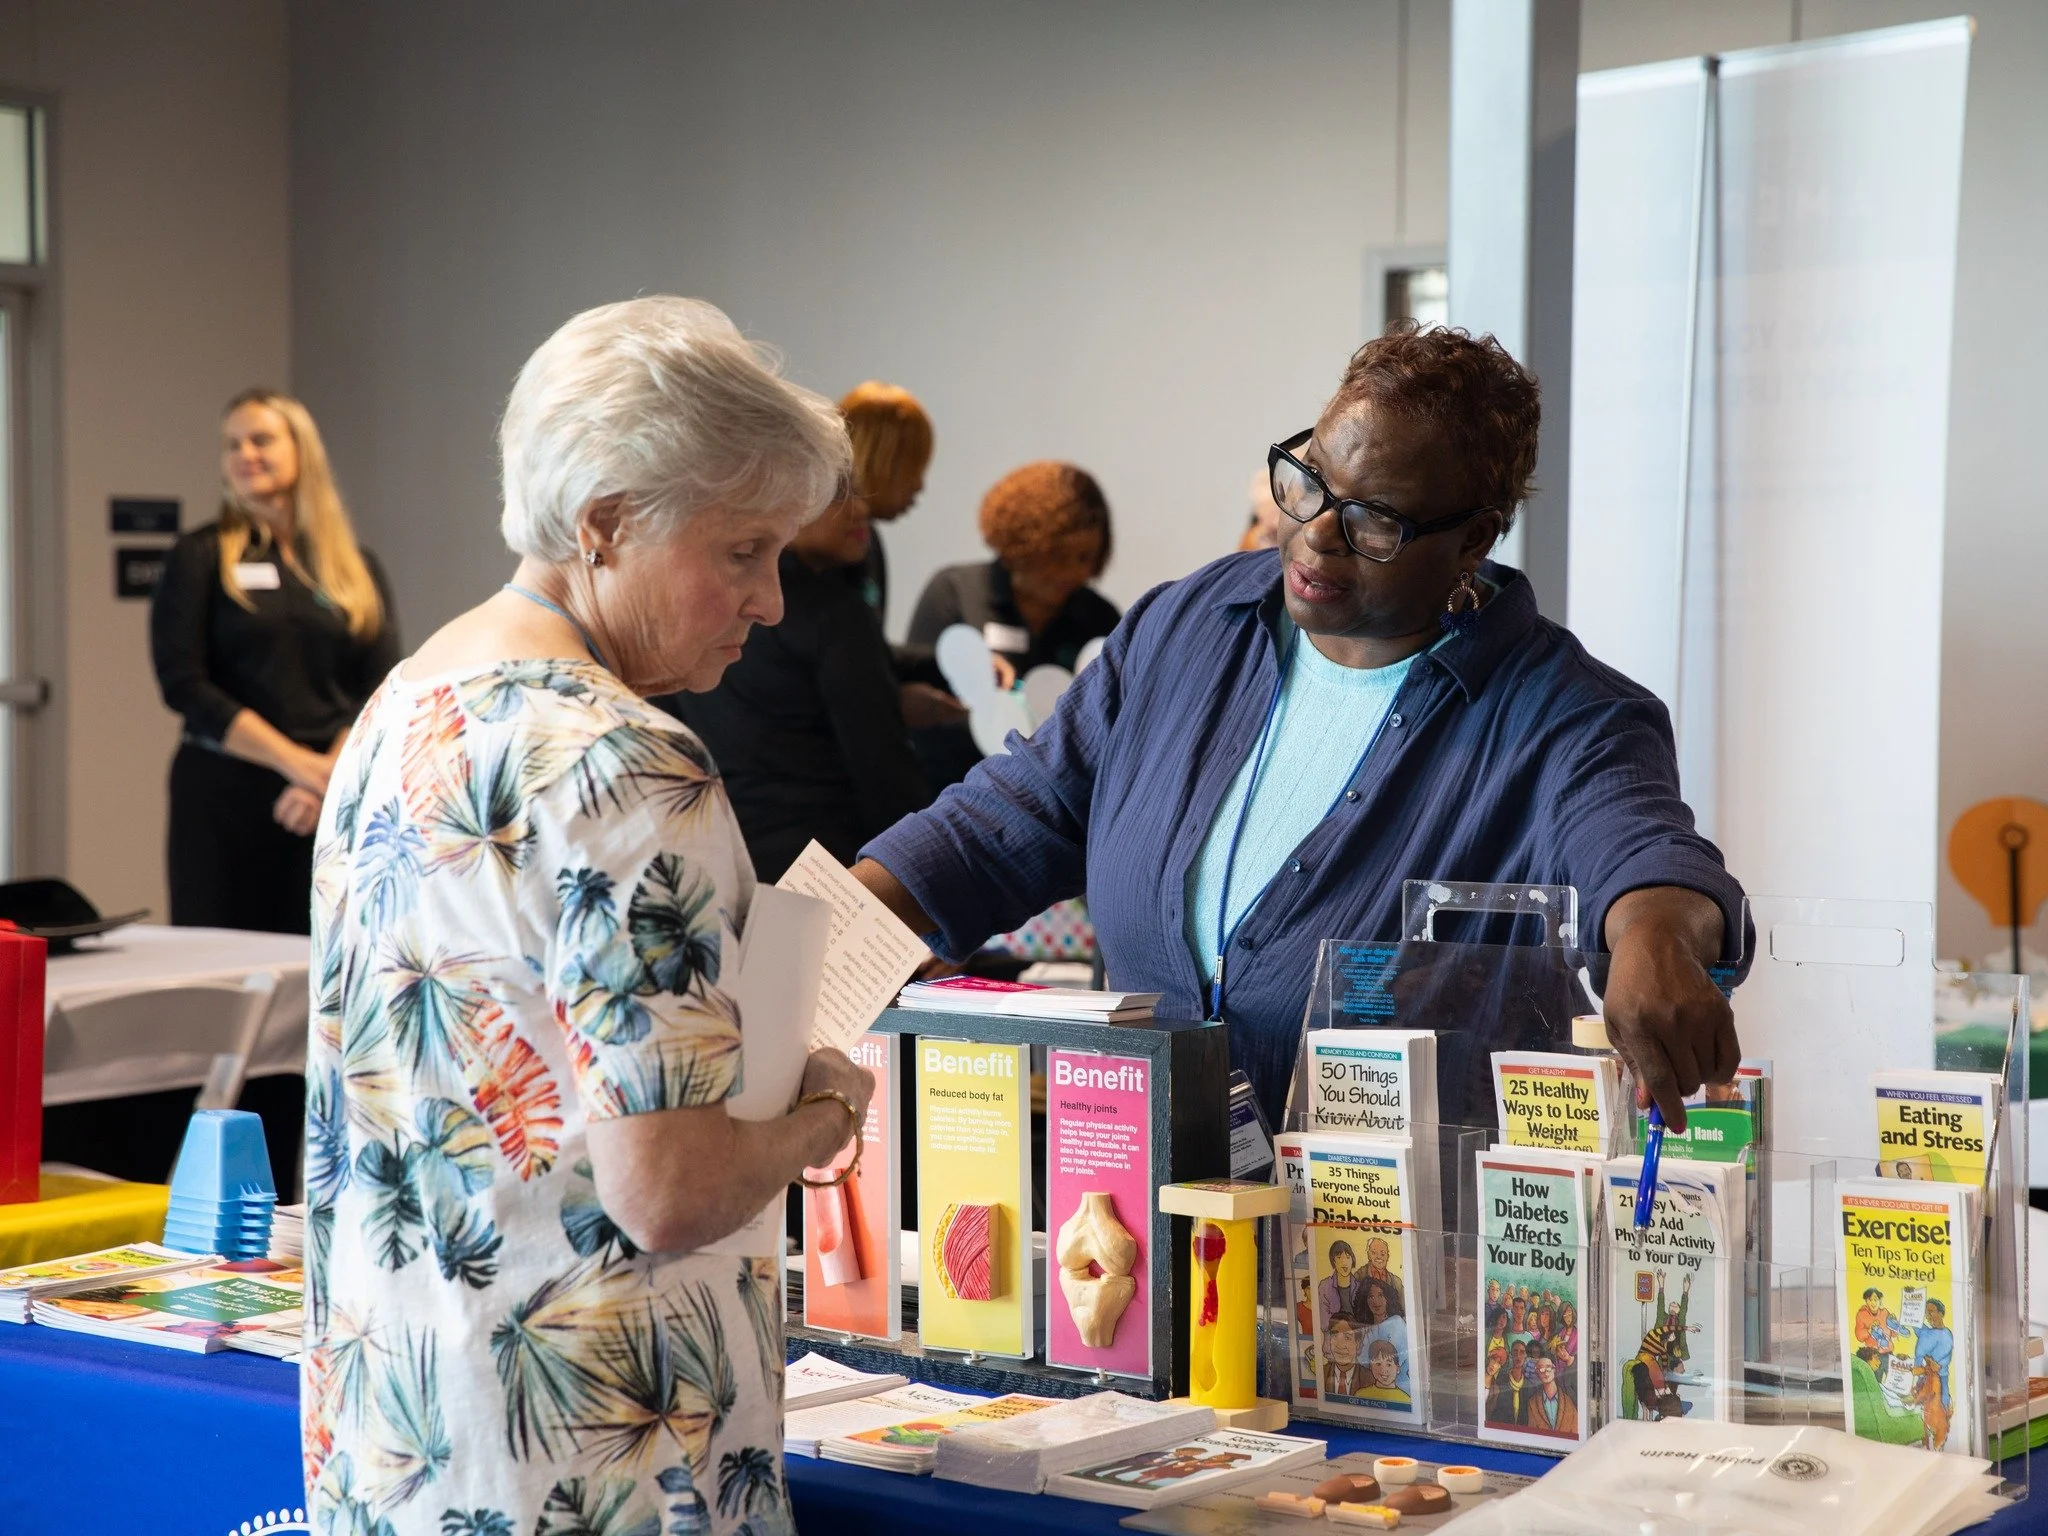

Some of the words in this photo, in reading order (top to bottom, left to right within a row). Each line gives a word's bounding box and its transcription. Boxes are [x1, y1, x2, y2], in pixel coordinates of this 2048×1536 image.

[849, 1042, 883, 1068] efit
[925, 1048, 1013, 1077] Benefit
[1055, 1060, 1144, 1093] Benefit
[1322, 1062, 1346, 1079] 50
[1349, 1065, 1398, 1088] Things
[1541, 1068, 1566, 1076] HEALTHY
[929, 1088, 967, 1099] Reduced
[969, 1090, 990, 1102] body
[993, 1092, 1004, 1101] fat
[1319, 1084, 1345, 1102] You
[1349, 1087, 1400, 1107] Should
[1510, 1080, 1528, 1096] 25
[1533, 1081, 1589, 1105] Healthy
[1885, 1090, 1909, 1098] WHEN
[1909, 1092, 1925, 1100] YOU
[1926, 1093, 1940, 1101] FEEL
[1941, 1094, 1973, 1104] STRESSED
[1060, 1100, 1092, 1113] Healthy
[1093, 1104, 1118, 1114] joints
[1502, 1099, 1543, 1120] Ways
[1546, 1104, 1562, 1118] to
[1566, 1104, 1600, 1121] Lose
[1060, 1118, 1085, 1128] Regular
[1086, 1121, 1113, 1130] physical
[1114, 1124, 1138, 1134] activity
[1315, 1106, 1357, 1126] Know
[1356, 1110, 1404, 1130] About
[1899, 1105, 1963, 1133] Eating
[1060, 1128, 1078, 1137] helps
[1079, 1131, 1095, 1139] keep
[1111, 1134, 1130, 1142] joints
[1527, 1122, 1579, 1144] Weight
[1694, 1126, 1724, 1142] Hands
[1881, 1128, 1918, 1146] and
[1923, 1129, 1984, 1153] Stress
[1060, 1137, 1083, 1147] healthy
[1097, 1141, 1121, 1150] flexible.
[1075, 1148, 1089, 1157] help
[1090, 1150, 1112, 1158] reduce
[1114, 1153, 1128, 1161] pain
[1328, 1155, 1351, 1163] DIABETES
[1075, 1167, 1096, 1176] joints.
[1088, 1160, 1123, 1169] experience
[1124, 1162, 1131, 1170] in
[1329, 1167, 1342, 1177] 35
[1345, 1168, 1380, 1183] Things
[1311, 1179, 1360, 1193] Everyone
[1363, 1183, 1400, 1196] Should
[1512, 1177, 1550, 1199] How
[1323, 1193, 1354, 1205] Know
[1357, 1196, 1390, 1209] About
[1619, 1194, 1634, 1208] 21
[1653, 1200, 1667, 1214] sy
[1681, 1193, 1702, 1202] ounts
[1880, 1200, 1896, 1208] TOO
[1495, 1198, 1569, 1224] Diabetes
[1312, 1208, 1403, 1235] Diabetes
[1660, 1217, 1684, 1231] Add
[1842, 1211, 1952, 1246] Exercise!
[1501, 1223, 1562, 1247] Affects
[1615, 1228, 1665, 1249] Phyical
[1669, 1234, 1715, 1254] Activity
[1487, 1244, 1527, 1267] Your
[1531, 1249, 1576, 1276] Body
[1628, 1249, 1641, 1262] to
[1645, 1248, 1674, 1265] Your
[1677, 1252, 1702, 1272] Day
[1851, 1243, 1872, 1258] Ten
[1875, 1245, 1901, 1264] Tips
[1904, 1248, 1919, 1263] To
[1922, 1250, 1945, 1265] Get
[1862, 1262, 1885, 1277] You
[1889, 1264, 1936, 1282] Started
[1370, 1400, 1387, 1408] FACTS
[1194, 1437, 1290, 1454] Grandchildren
[1230, 1436, 1281, 1447] Raising
[1640, 1450, 1699, 1460] Health
[1705, 1454, 1765, 1465] Public
